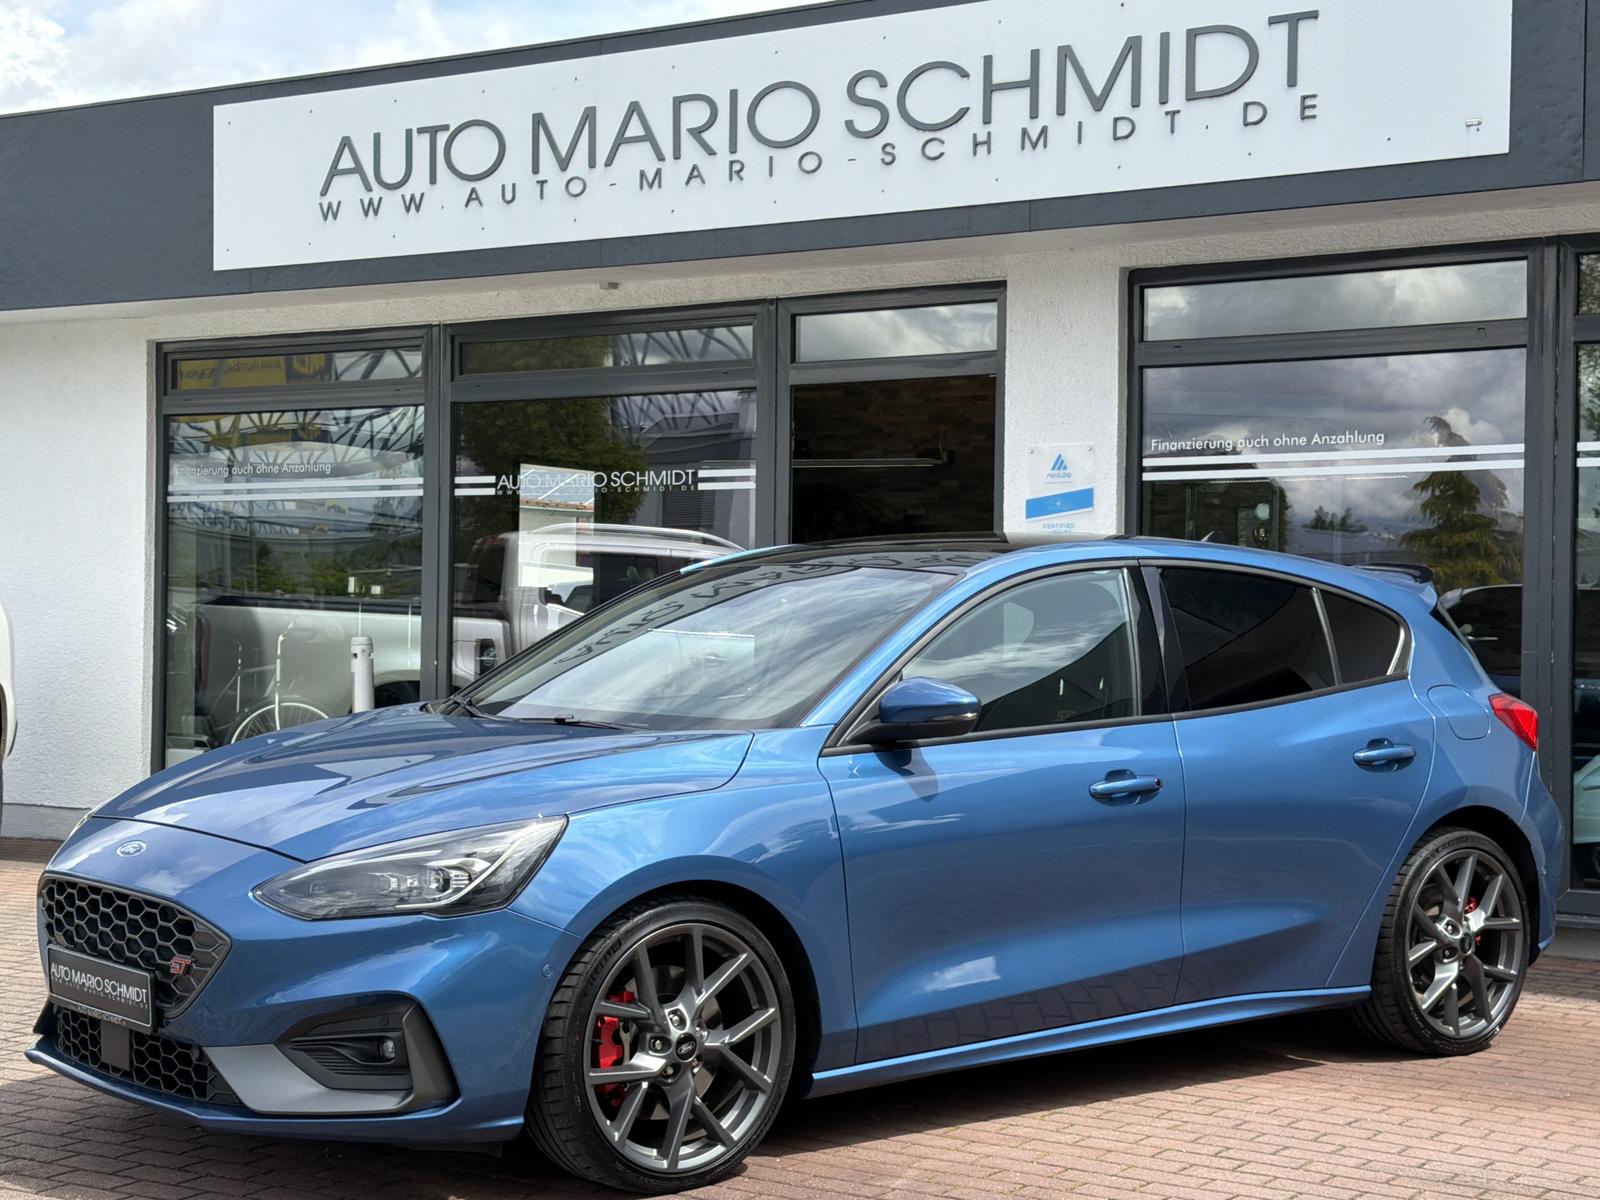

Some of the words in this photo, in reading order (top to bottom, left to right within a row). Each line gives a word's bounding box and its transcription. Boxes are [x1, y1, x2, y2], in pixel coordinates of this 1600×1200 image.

[319, 119, 507, 197] AUTO
[531, 80, 821, 177] MARIO
[845, 14, 1320, 140] SCHMIDT
[1151, 437, 1233, 451] Finanzierung
[1237, 434, 1269, 448] auch
[1274, 433, 1307, 447] ohne
[1311, 430, 1385, 446] Anzahlung
[231, 464, 253, 476] auch
[255, 463, 279, 475] ohne
[281, 461, 332, 475] Anzahlung
[497, 473, 542, 490] AUTO
[544, 471, 608, 489] MARIO
[610, 470, 695, 488] SCHMIDT
[170, 957, 191, 975] ST
[50, 962, 71, 981] AUTO
[72, 969, 103, 991] MARIO
[104, 979, 147, 1003] SCHMIDT
